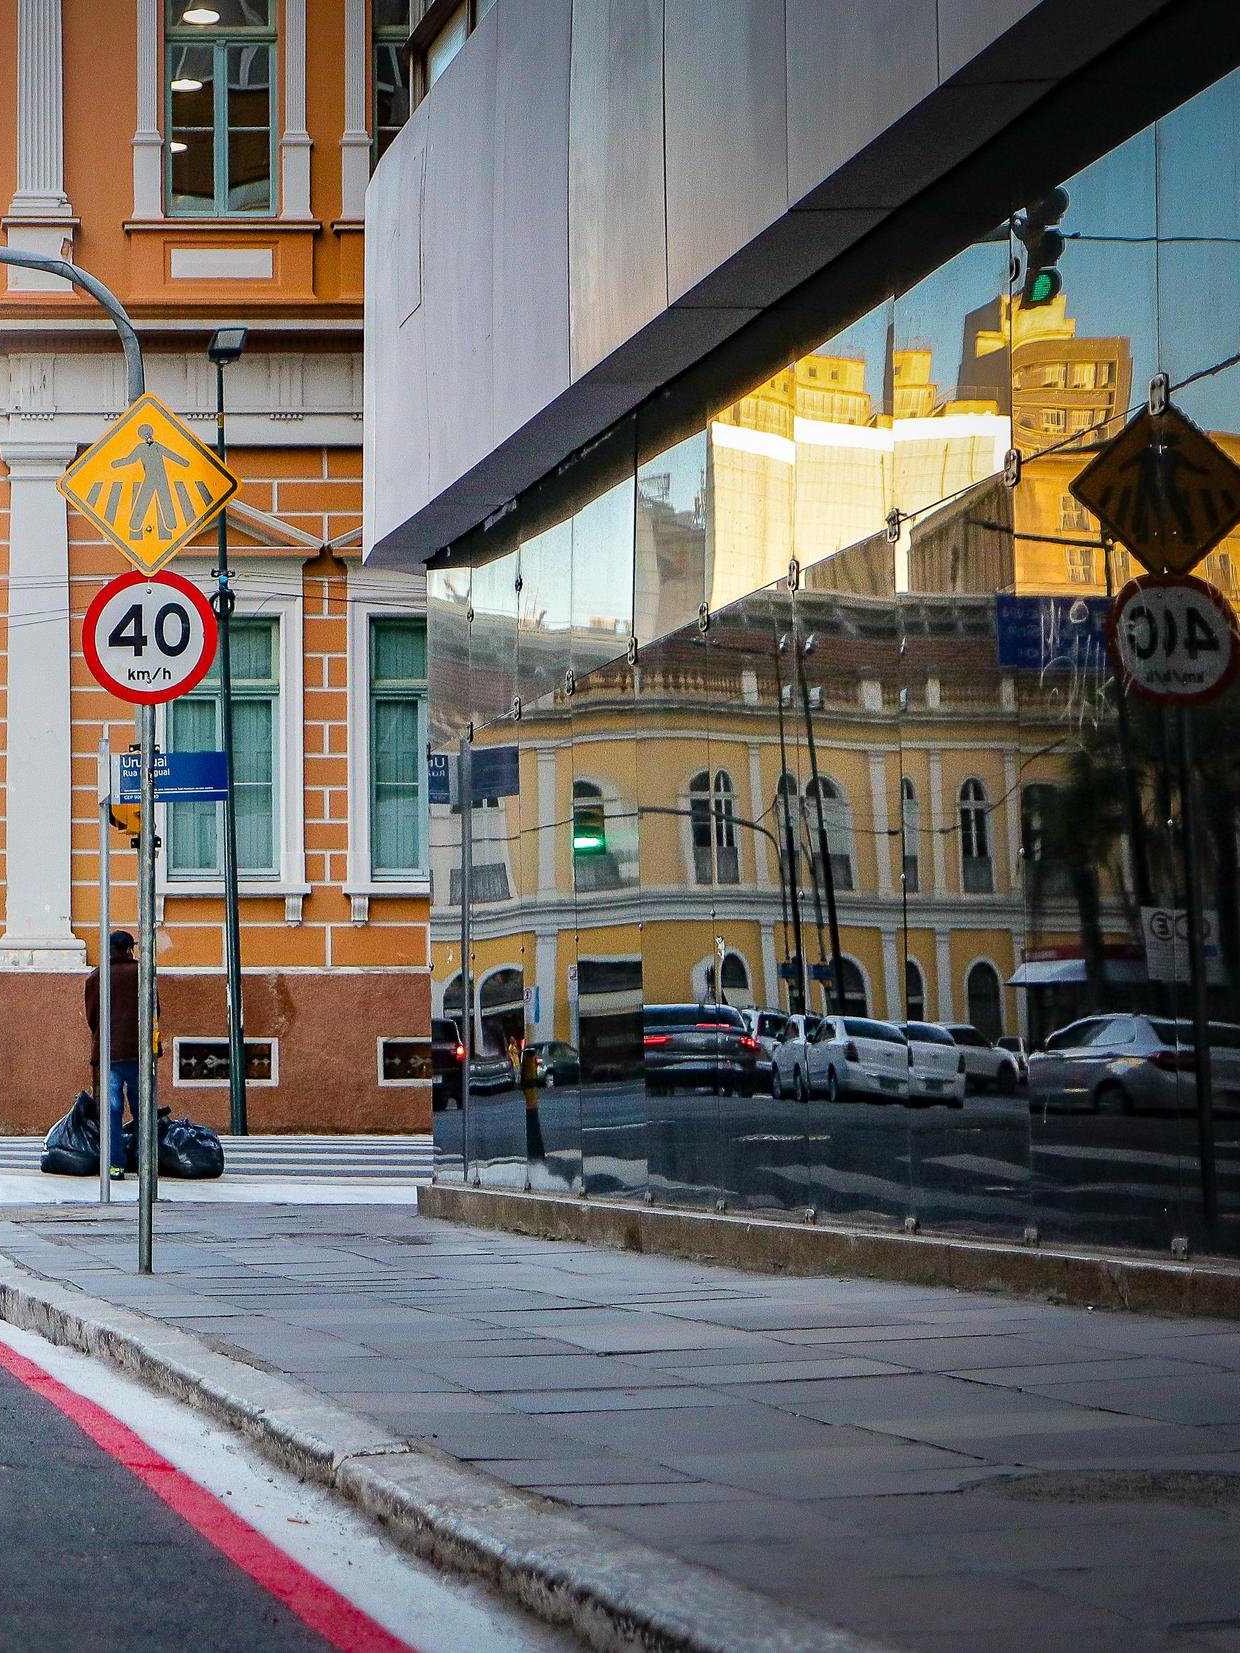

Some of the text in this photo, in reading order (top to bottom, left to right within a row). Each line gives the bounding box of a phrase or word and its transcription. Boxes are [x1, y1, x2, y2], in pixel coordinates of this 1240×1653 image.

[108, 603, 190, 657] 40
[128, 667, 171, 681] km/h
[123, 769, 138, 777] Rua
